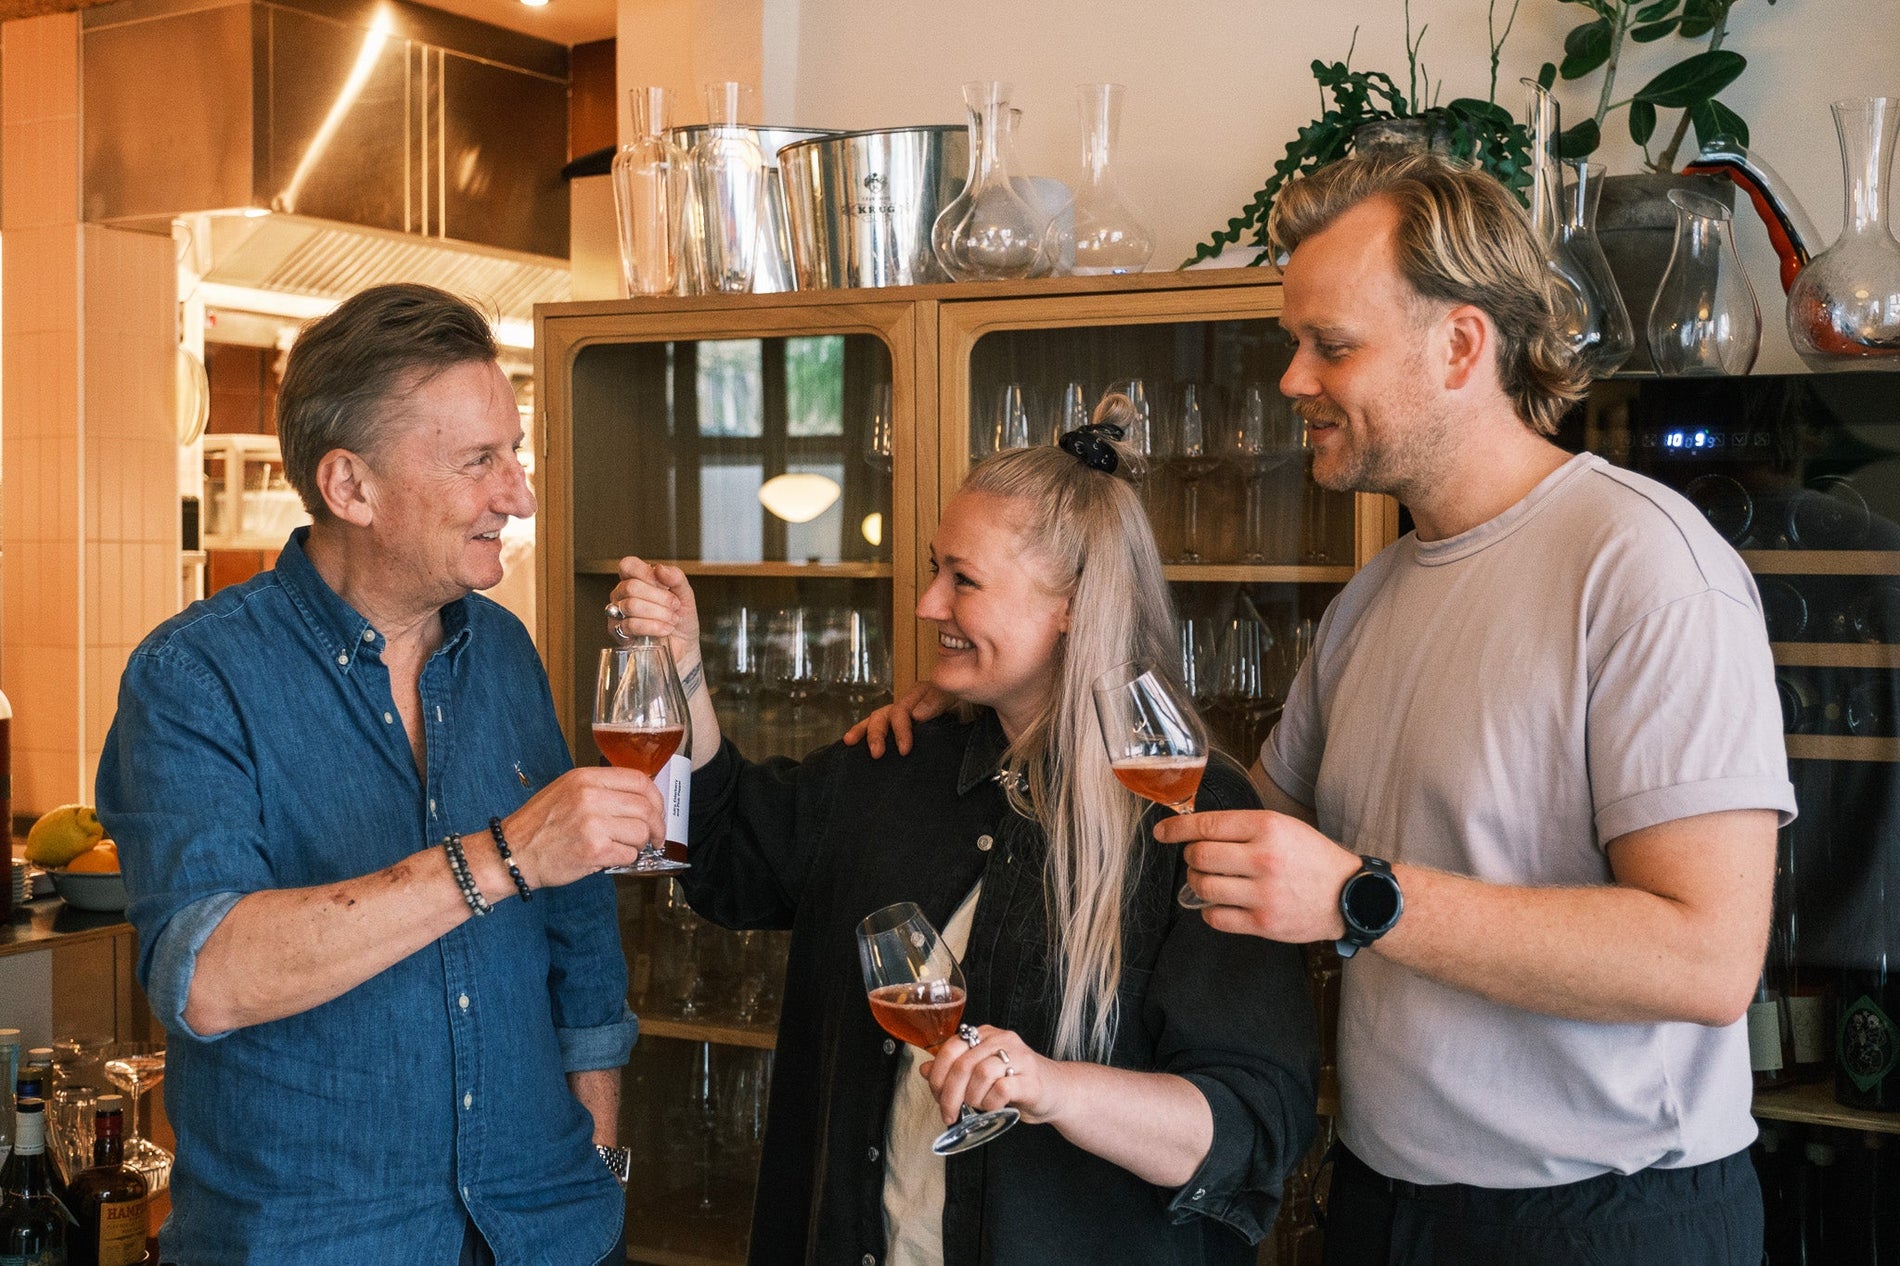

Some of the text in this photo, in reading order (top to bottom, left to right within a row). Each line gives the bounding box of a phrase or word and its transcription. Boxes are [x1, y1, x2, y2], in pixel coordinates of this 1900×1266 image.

[858, 206, 895, 214] KRUG
[1667, 432, 1705, 447] 10 9
